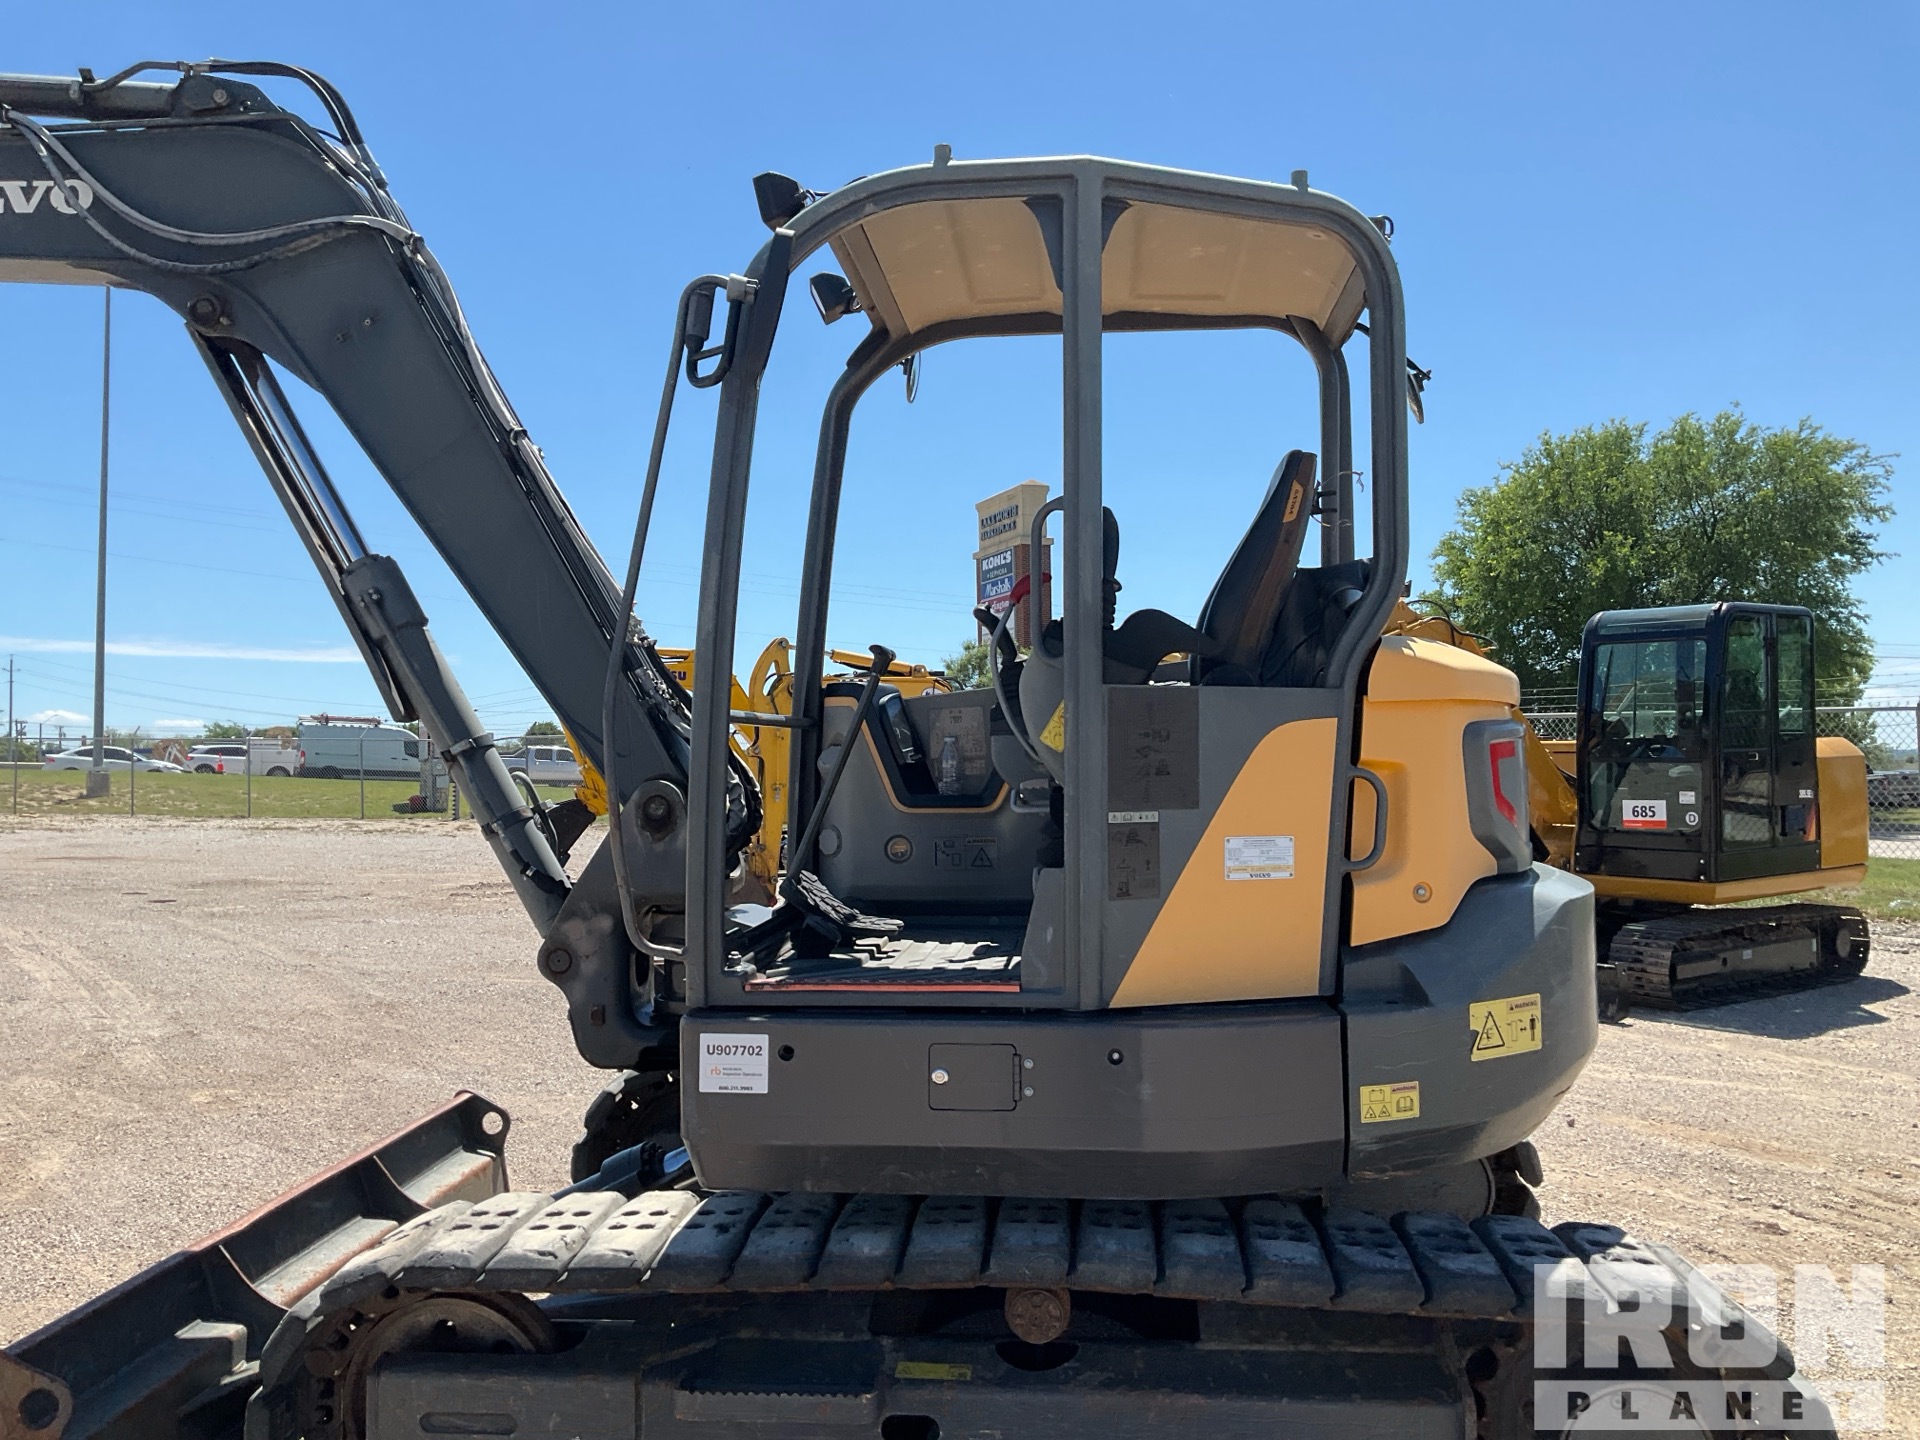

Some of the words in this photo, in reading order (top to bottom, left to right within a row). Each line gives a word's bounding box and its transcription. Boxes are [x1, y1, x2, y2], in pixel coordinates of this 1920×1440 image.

[0, 179, 93, 214] VO
[982, 551, 1011, 571] KOHL'S
[985, 577, 1011, 598] Marshalls
[1632, 806, 1656, 818] 685
[1688, 813, 1696, 823] D
[1514, 1000, 1538, 1010] WARNING
[706, 1044, 763, 1056] U907702
